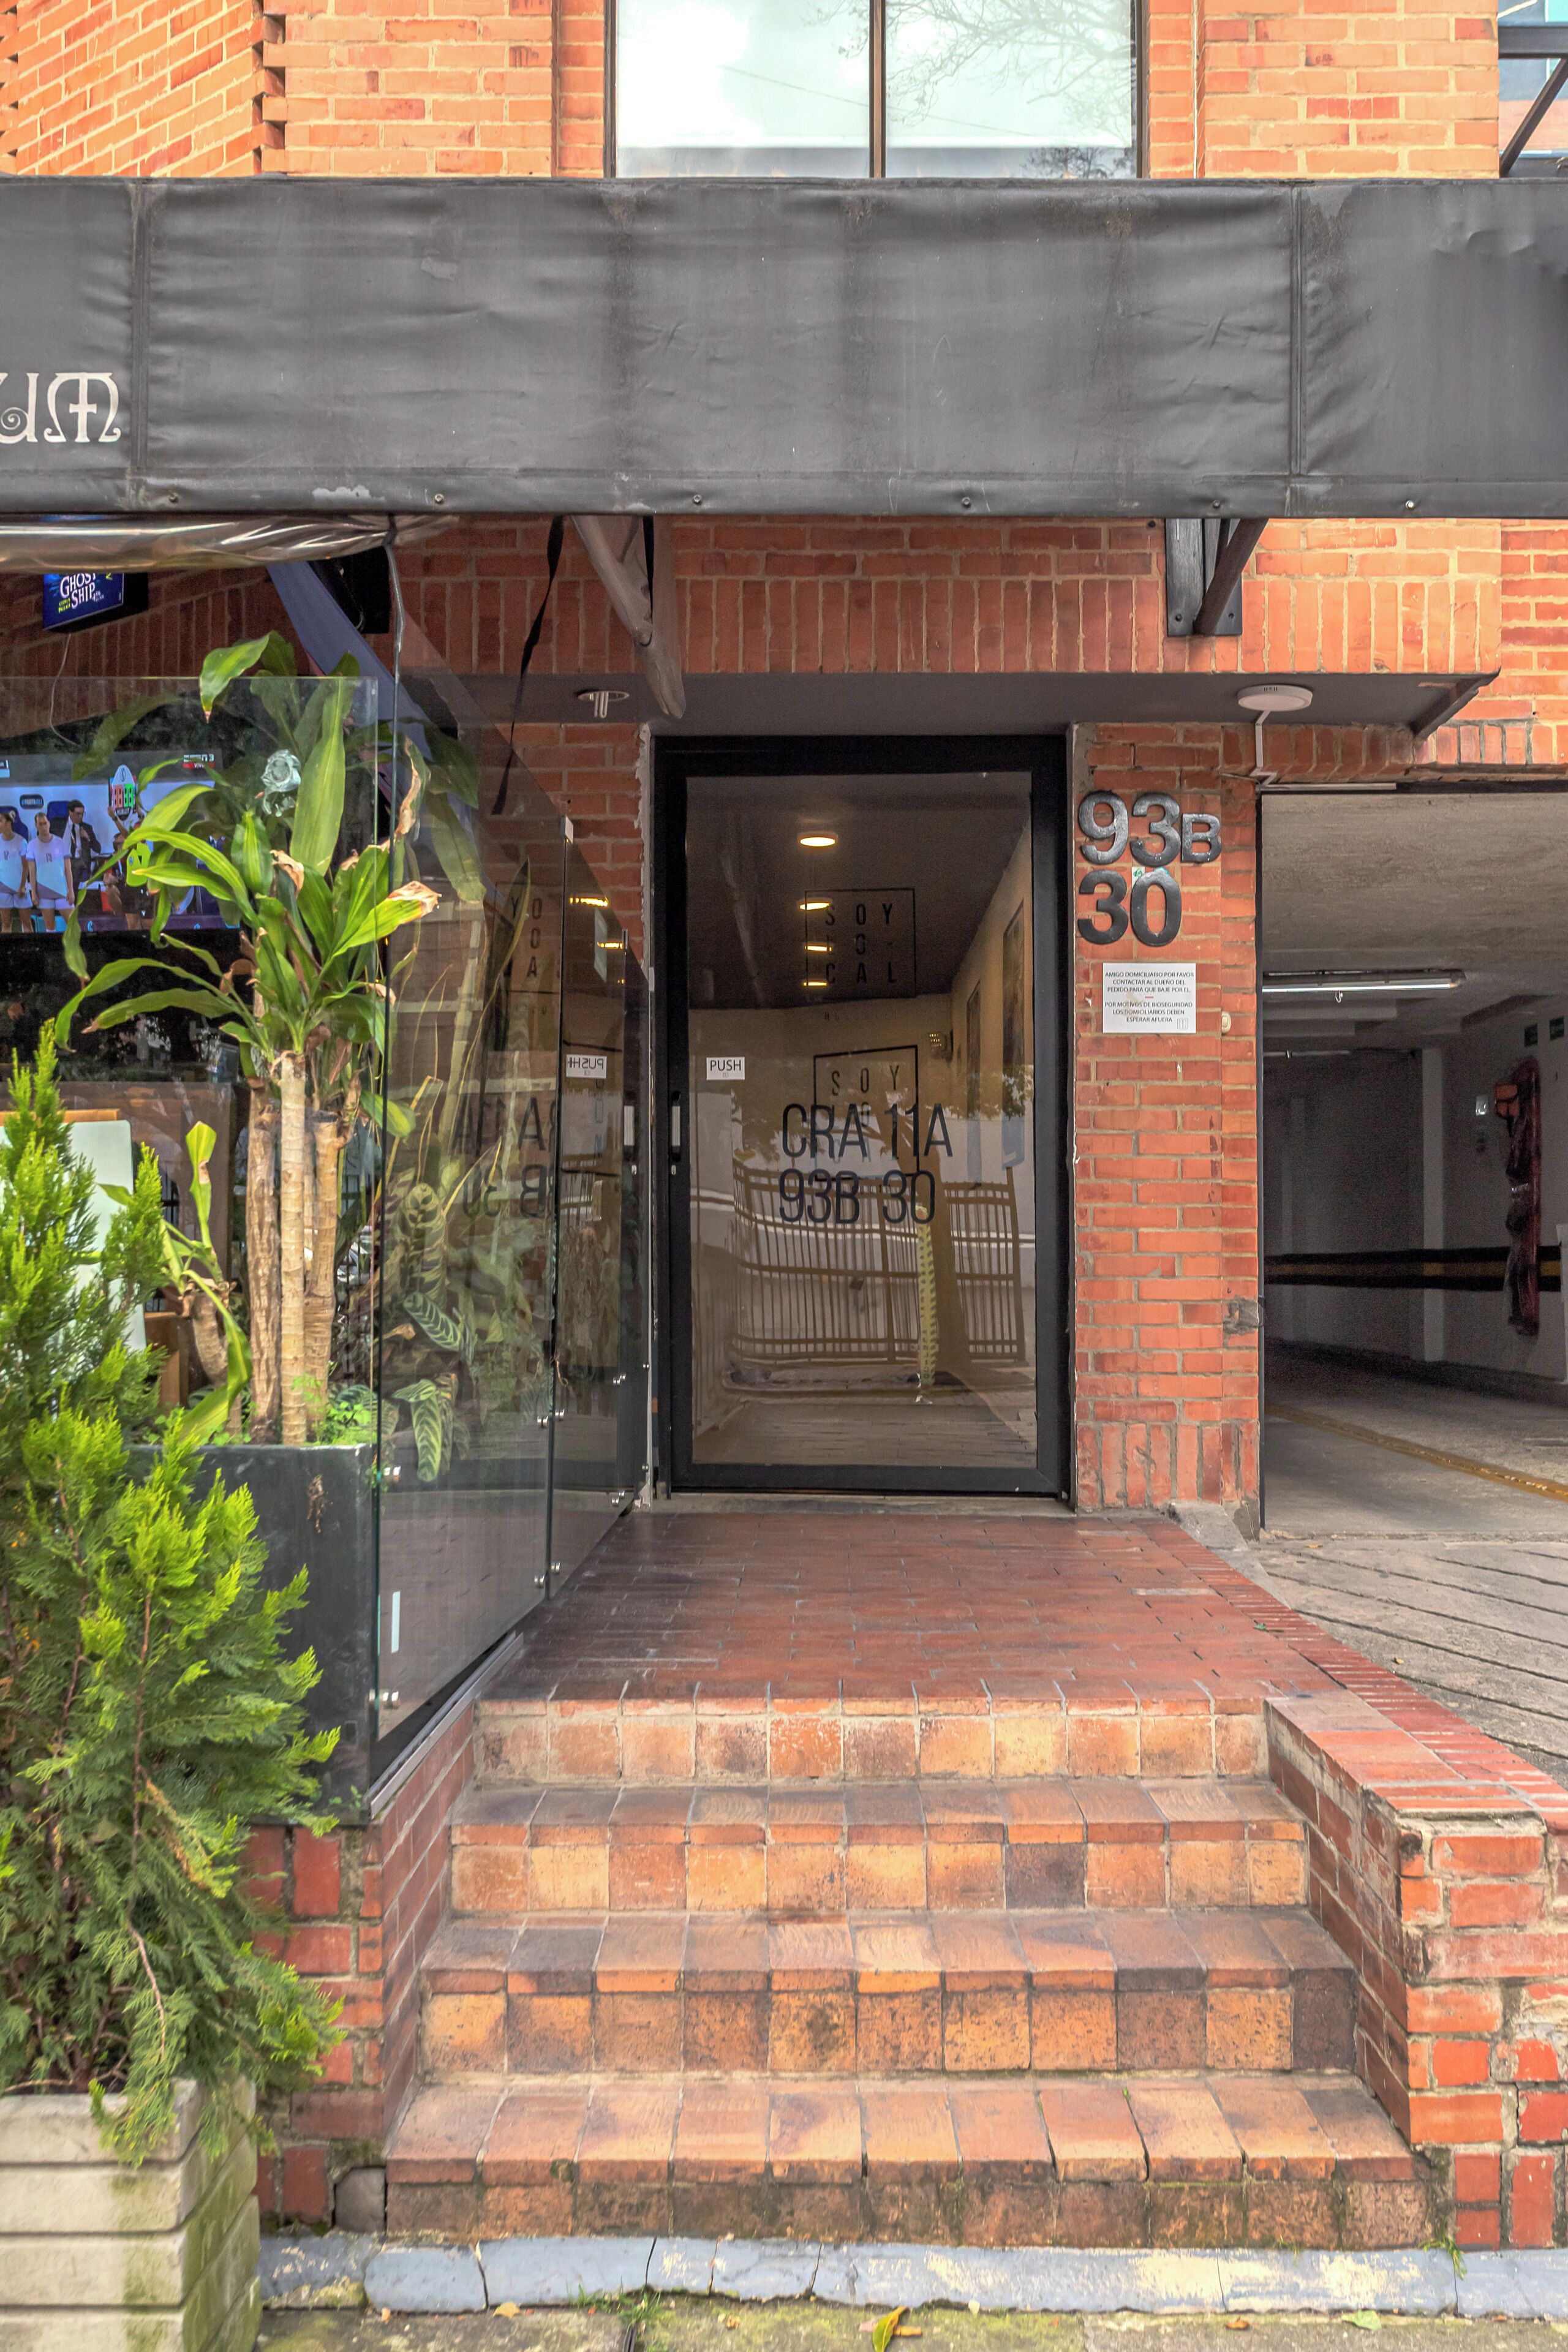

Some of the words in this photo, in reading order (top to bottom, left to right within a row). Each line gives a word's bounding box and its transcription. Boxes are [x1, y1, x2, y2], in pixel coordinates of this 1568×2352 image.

[71, 582, 96, 609] SHIP
[825, 903, 892, 926] SOY
[1077, 870, 1182, 947] 30
[826, 962, 897, 984] CAL
[710, 1059, 741, 1071] PUSH
[831, 1065, 900, 1096] SOY
[782, 1103, 868, 1159] CRA
[884, 1102, 953, 1158] 11A
[779, 1167, 860, 1224] 93B
[882, 1169, 936, 1224] 30
